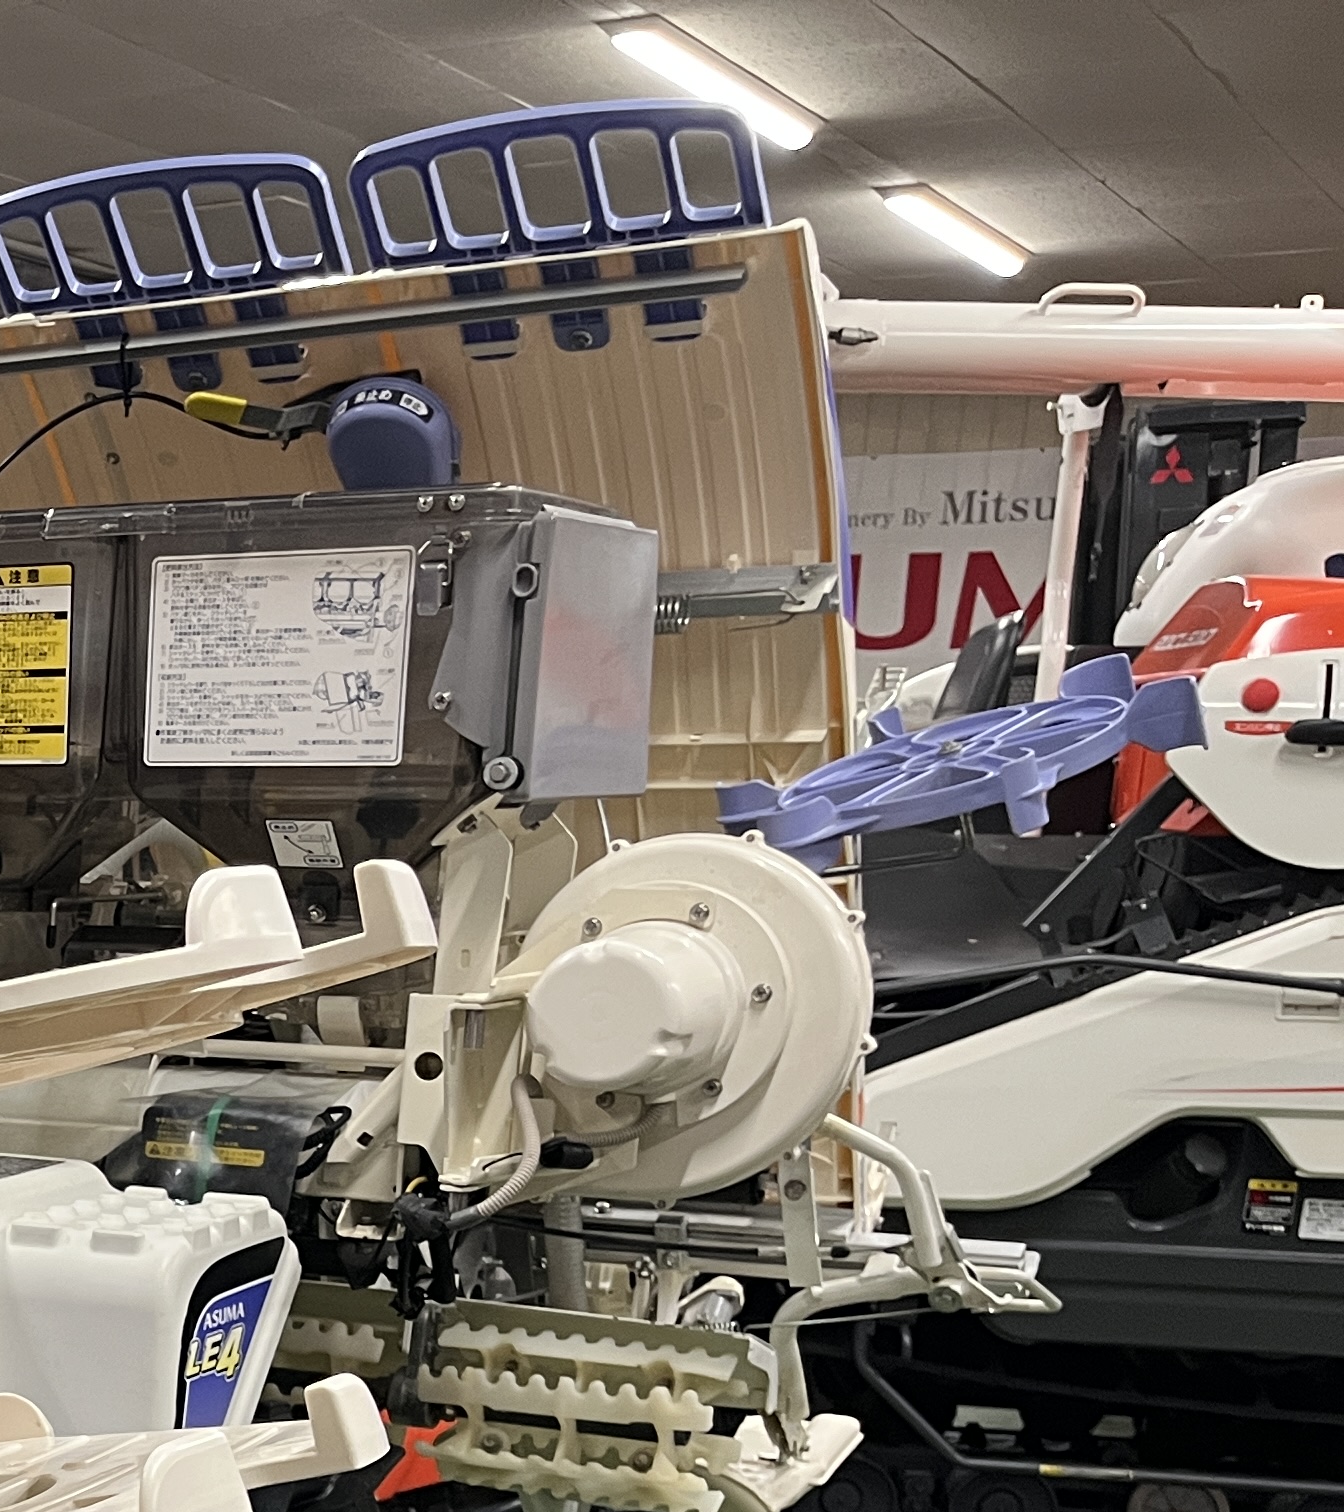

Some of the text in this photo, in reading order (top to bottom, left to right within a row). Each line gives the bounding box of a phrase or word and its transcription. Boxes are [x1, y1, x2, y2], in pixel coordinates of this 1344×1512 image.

[903, 507, 931, 528] By
[9, 569, 40, 584] 注意
[203, 1302, 245, 1331] ASUMA
[185, 1323, 245, 1382] LE4
